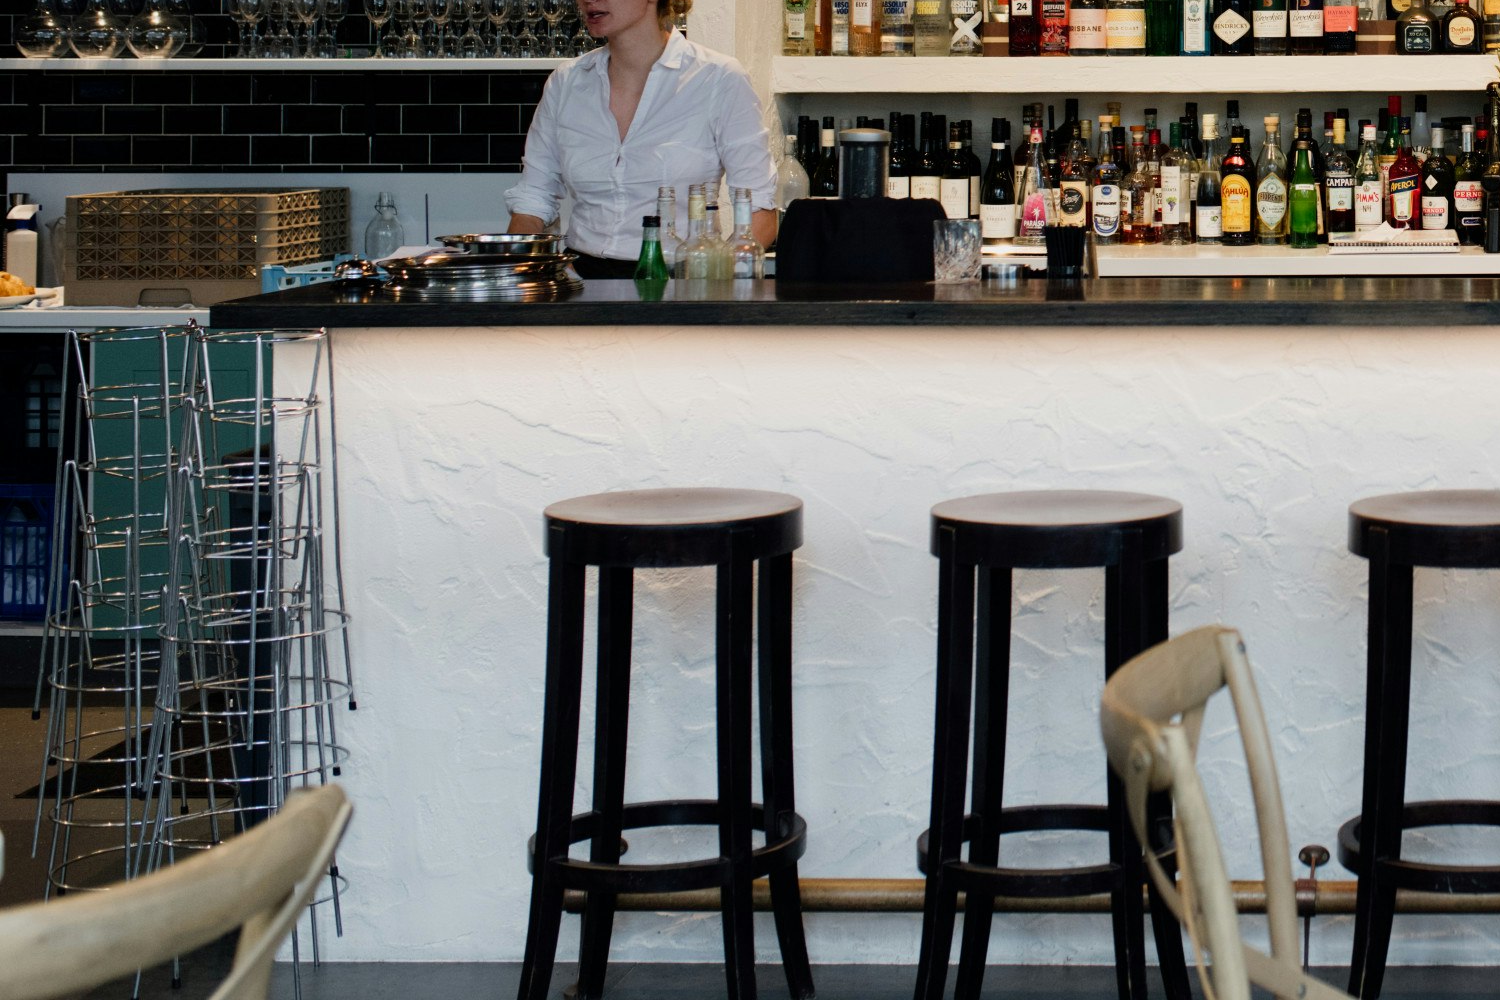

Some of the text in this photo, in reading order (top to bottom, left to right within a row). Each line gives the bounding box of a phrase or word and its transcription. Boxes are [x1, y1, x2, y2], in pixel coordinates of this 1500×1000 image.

[1016, 3, 1027, 11] 24
[1326, 178, 1355, 187] CAMPAR
[1390, 180, 1415, 193] APEROL
[1356, 191, 1380, 202] PIMM'S
